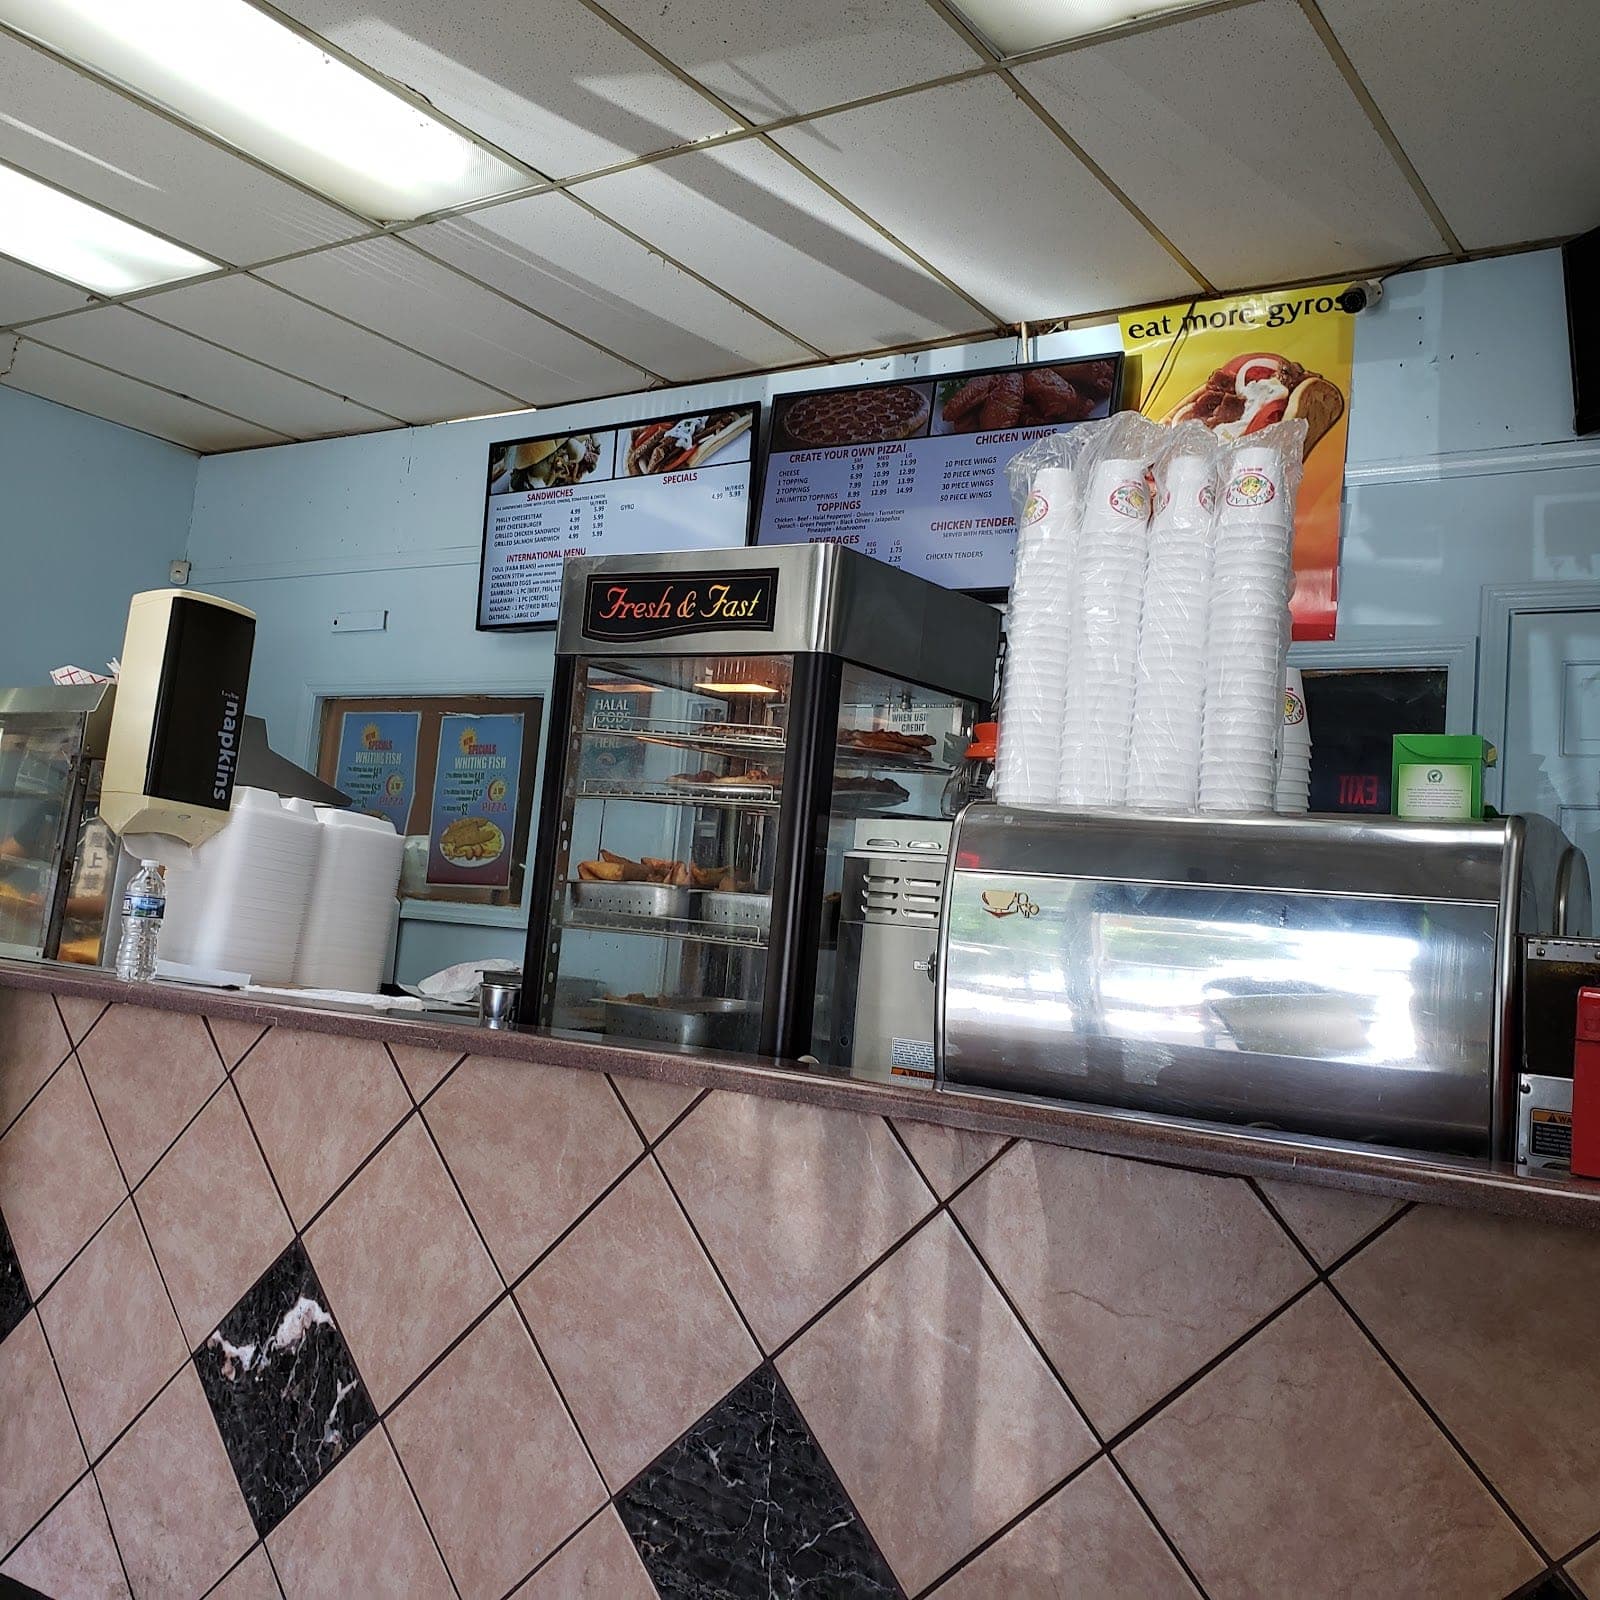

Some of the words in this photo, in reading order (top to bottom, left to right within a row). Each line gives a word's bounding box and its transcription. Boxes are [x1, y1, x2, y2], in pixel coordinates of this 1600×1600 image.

[1128, 316, 1170, 340] eat
[1184, 309, 1256, 330] more
[976, 432, 1018, 445] CHICKEN
[790, 452, 822, 463] CREATE
[824, 450, 848, 459] YOUR
[851, 448, 874, 457] OWN
[878, 444, 906, 455] PIZZA!
[663, 473, 697, 484] SPECIALS
[527, 489, 574, 501] SANDWICHES
[775, 496, 807, 504] UNLIMITED
[969, 491, 992, 499] WINGS
[817, 501, 861, 512] TOPPINGS
[512, 514, 542, 522] CHEESESTEAK
[507, 522, 541, 530] CHEESEBURGER
[930, 520, 972, 531] CHICKEN
[975, 517, 1016, 528] TENDER
[534, 527, 560, 535] SANDWICH
[507, 550, 562, 562] INTERNATIONAL
[564, 548, 586, 556] MENU
[600, 586, 674, 618] Fresh
[677, 591, 697, 618] &
[700, 584, 762, 617] Fast
[595, 699, 628, 710] HALAL
[892, 713, 911, 722] WHEN
[901, 723, 925, 732] CREDIT
[214, 701, 239, 800] napkins
[468, 744, 496, 754] SPECIALS
[386, 753, 402, 765] FISH
[455, 757, 487, 769] WHITING
[489, 757, 506, 768] FISH
[482, 802, 507, 811] PIZZA
